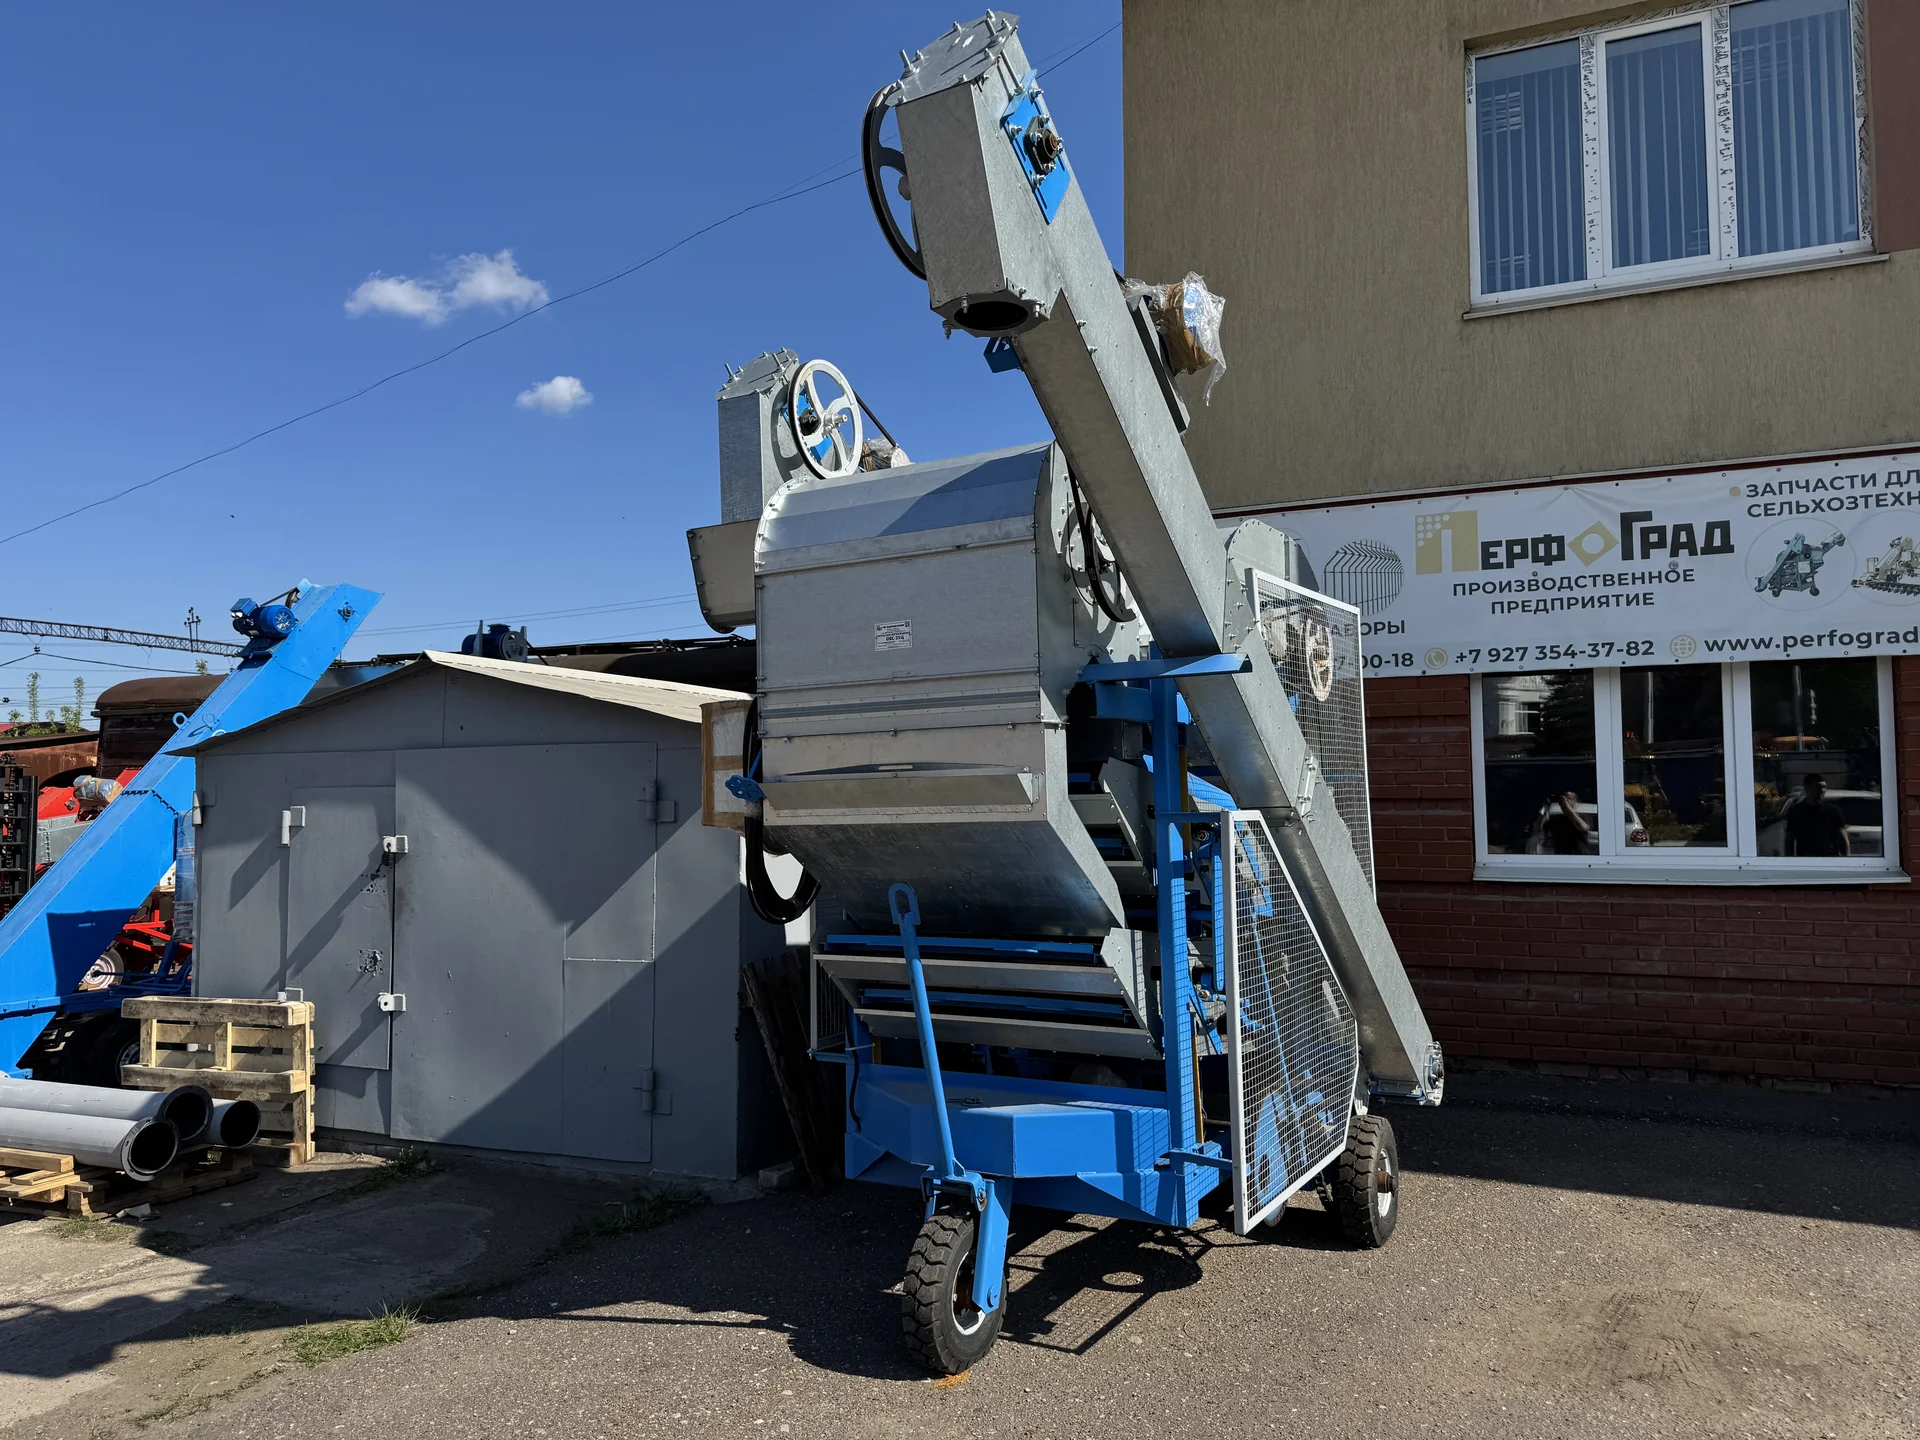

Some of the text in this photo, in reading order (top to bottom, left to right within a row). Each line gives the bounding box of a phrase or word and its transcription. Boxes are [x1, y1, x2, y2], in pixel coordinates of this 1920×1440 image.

[1746, 472, 1877, 498] ЗАПЧАСТИ
[1747, 490, 1920, 518] СЕЛЬХОЗТЕХН
[1453, 568, 1695, 597] ПРОИЗВОДСТВЕННОЕ
[1491, 592, 1655, 615] ПРЕДПРИЯТИЕ
[1456, 640, 1655, 664] +7 927 354-37-82
[1704, 626, 1919, 652] www.perfograd
